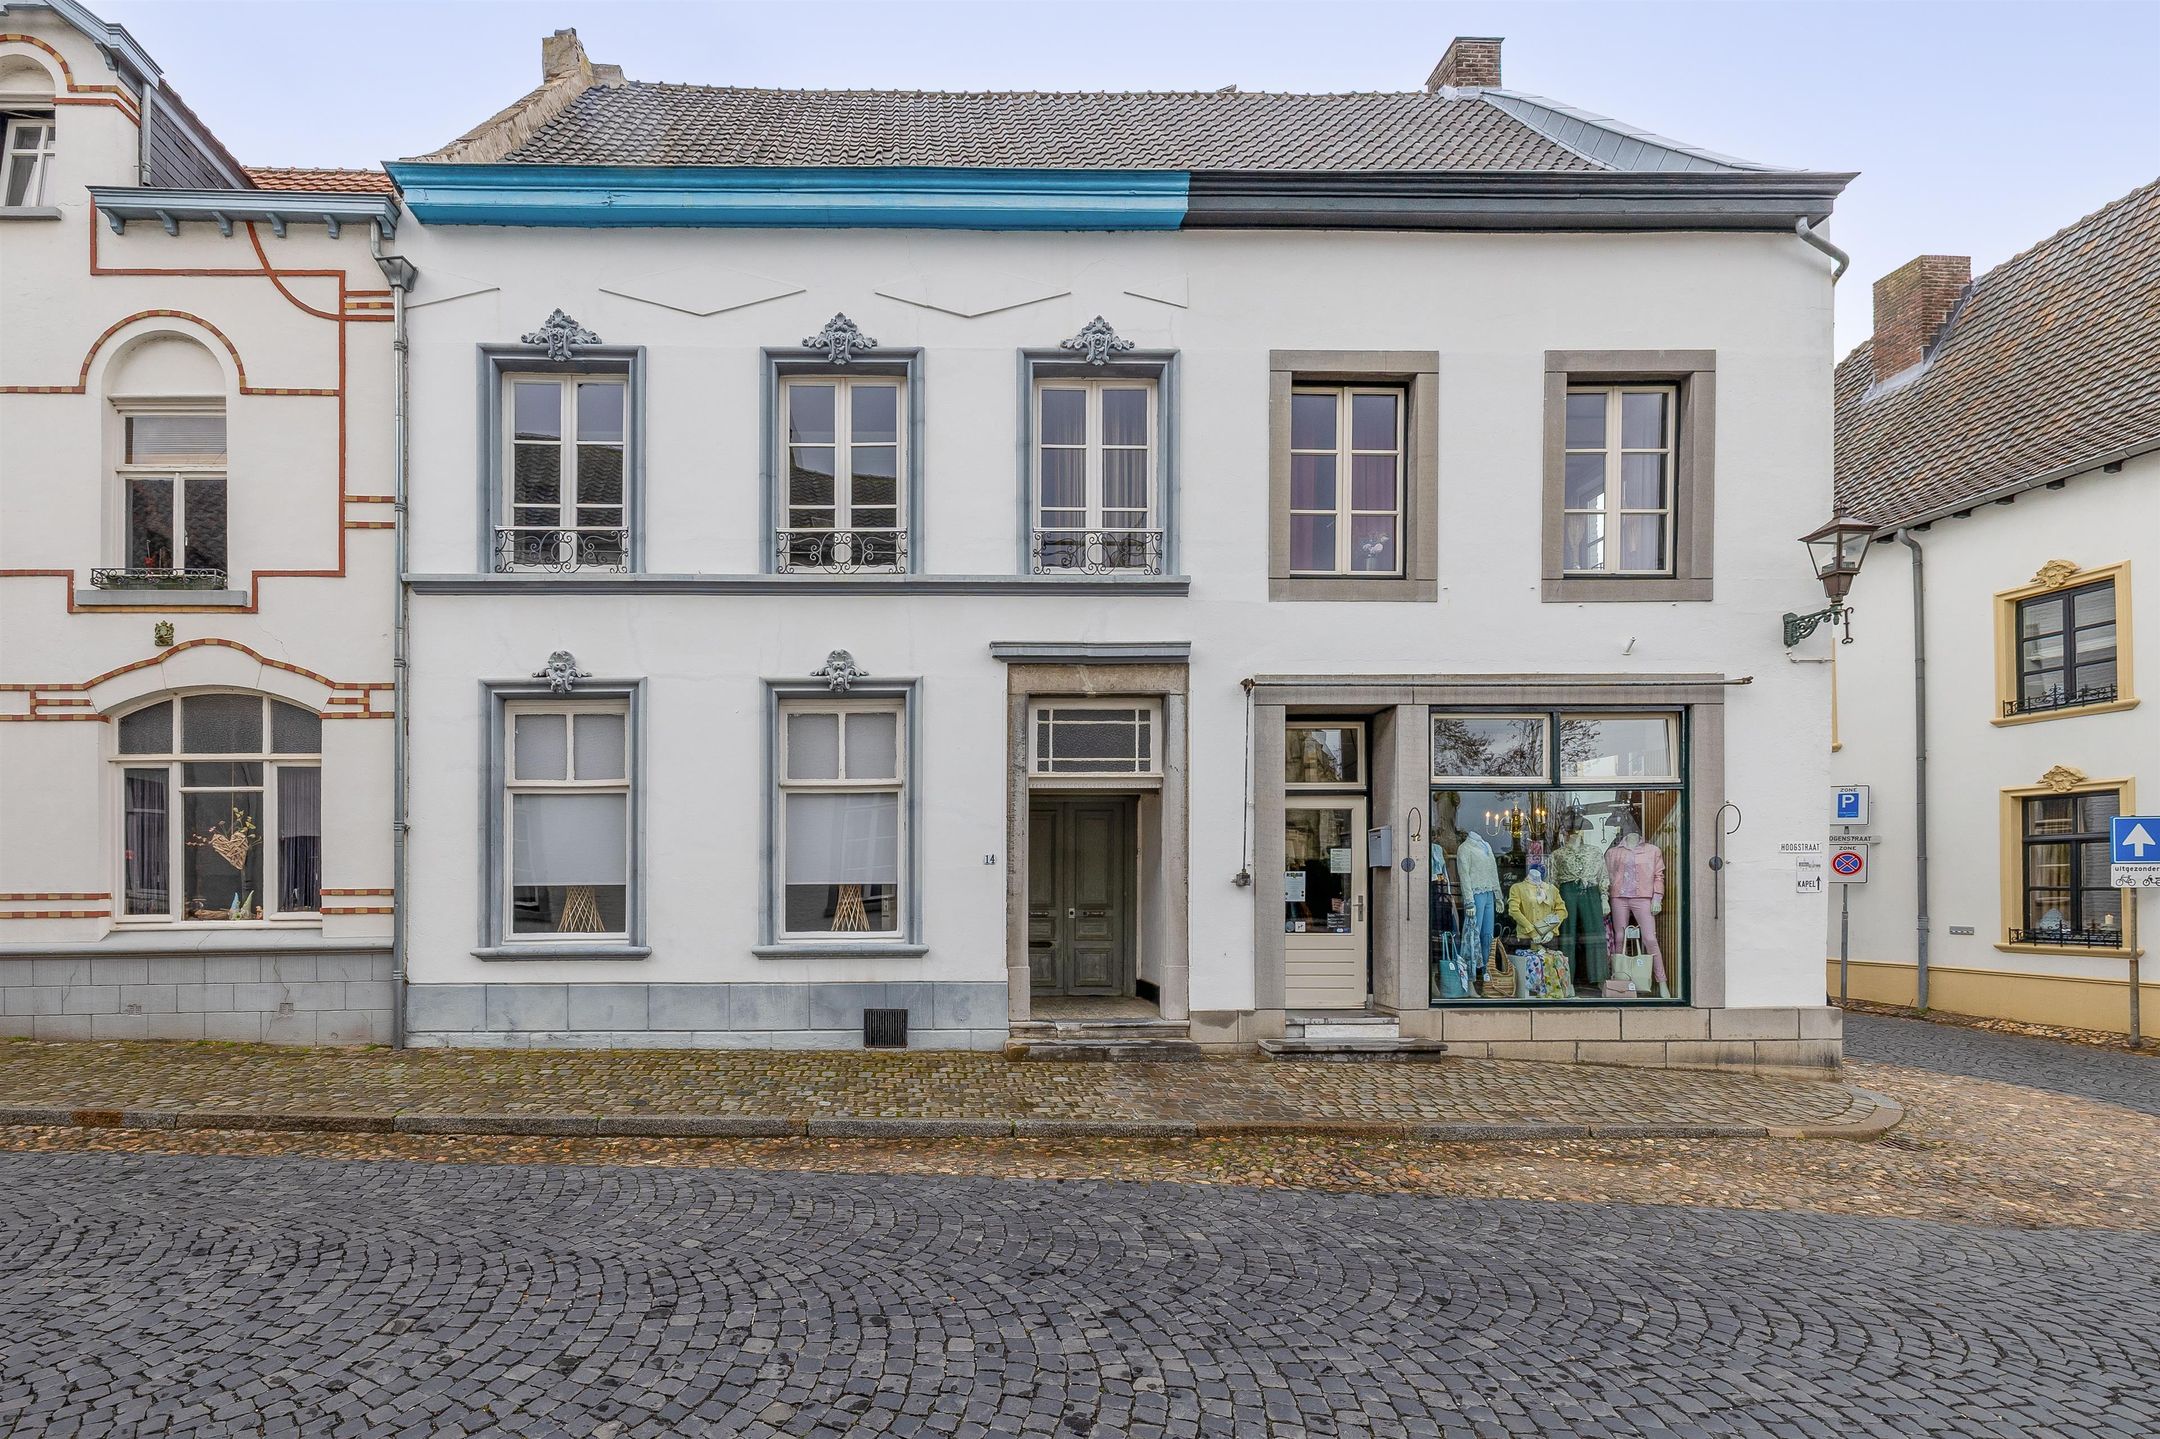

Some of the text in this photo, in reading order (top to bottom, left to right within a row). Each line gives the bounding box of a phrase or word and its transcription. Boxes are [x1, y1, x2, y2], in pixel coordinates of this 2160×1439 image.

[1842, 795, 1854, 808] P
[1780, 843, 1820, 852] HOOGSTRAAT
[985, 854, 995, 864] 14
[1797, 880, 1816, 888] KAPEL
